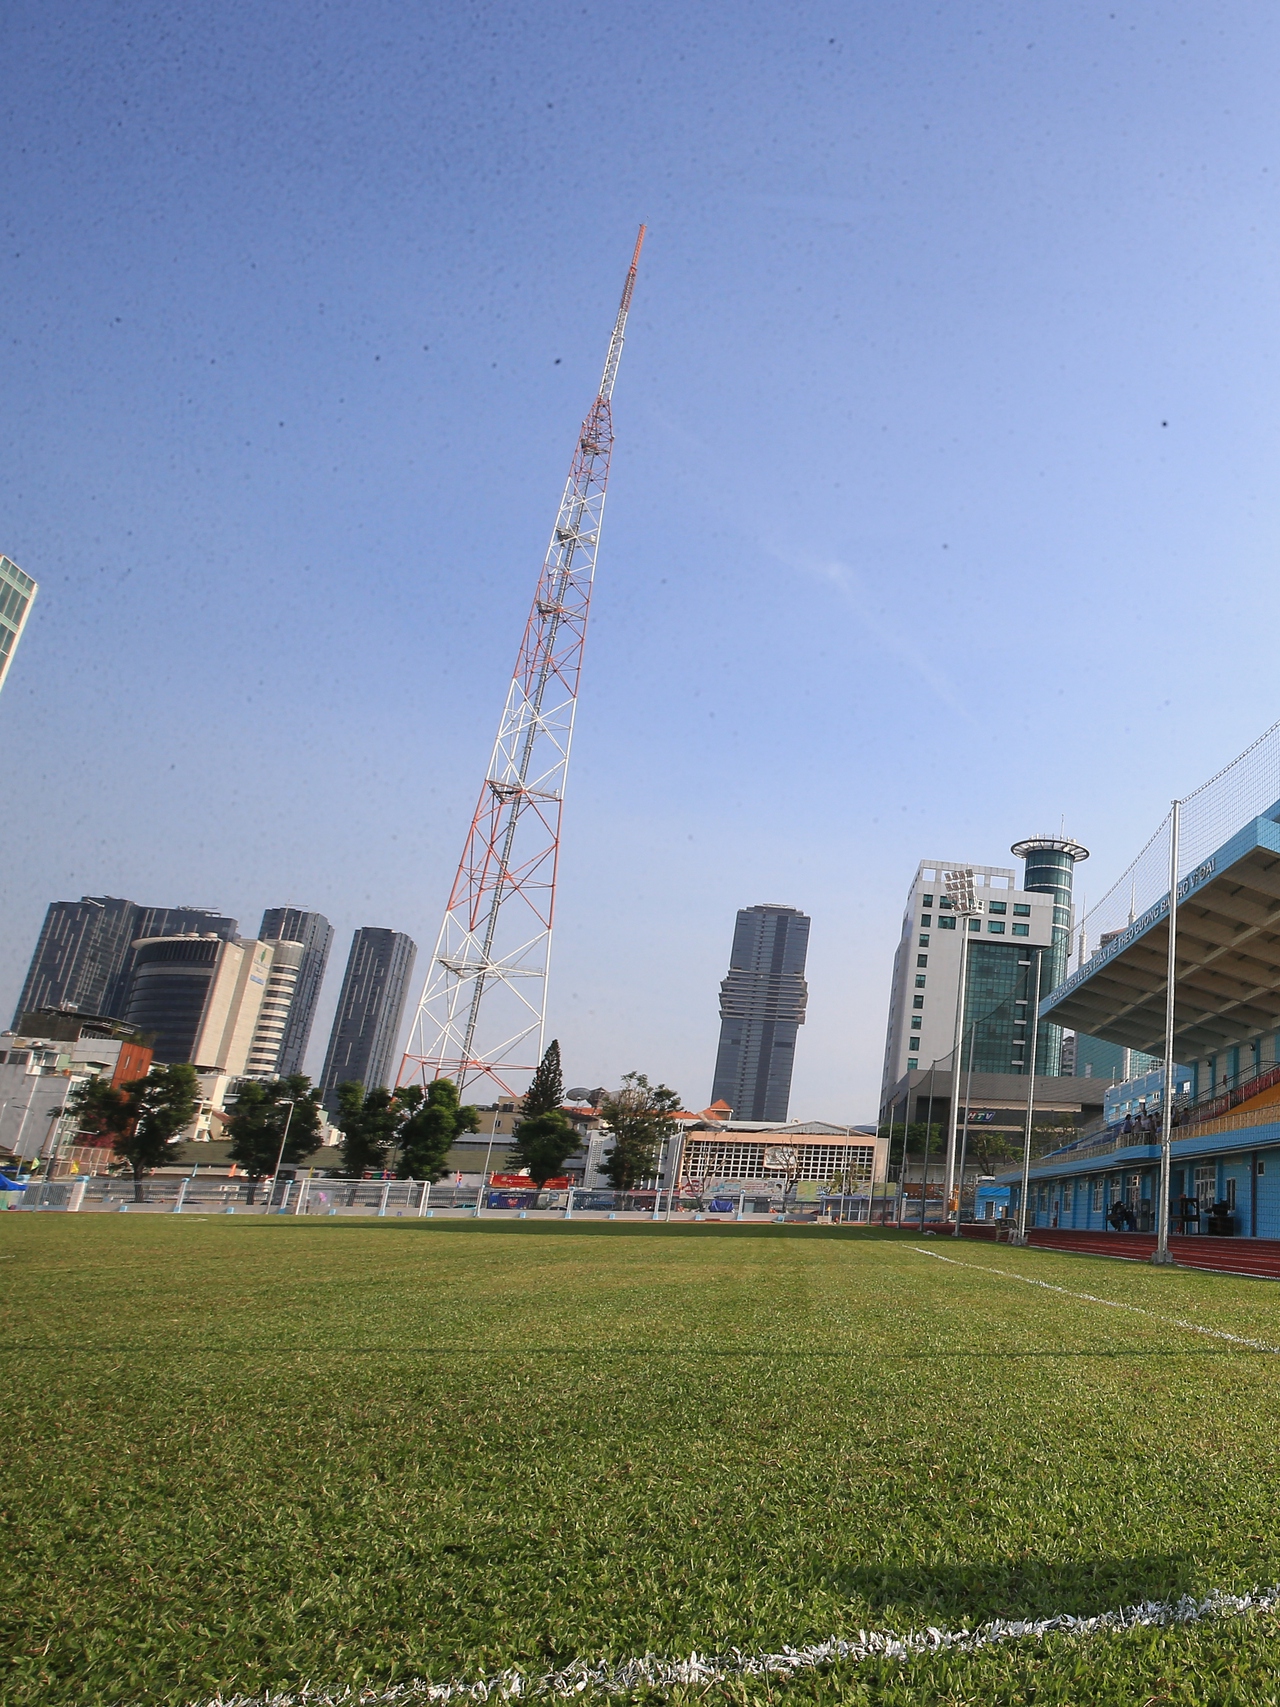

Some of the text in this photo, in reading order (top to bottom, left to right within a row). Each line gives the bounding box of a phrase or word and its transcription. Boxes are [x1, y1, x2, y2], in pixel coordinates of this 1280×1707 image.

[1093, 950, 1108, 969] THÂN
[1107, 936, 1119, 957] THỂ
[1118, 928, 1134, 949] THEO
[1177, 876, 1189, 901] HỒ
[1190, 869, 1199, 888] VĨ
[1199, 857, 1216, 880] ĐẠI
[967, 1112, 994, 1120] HTV
